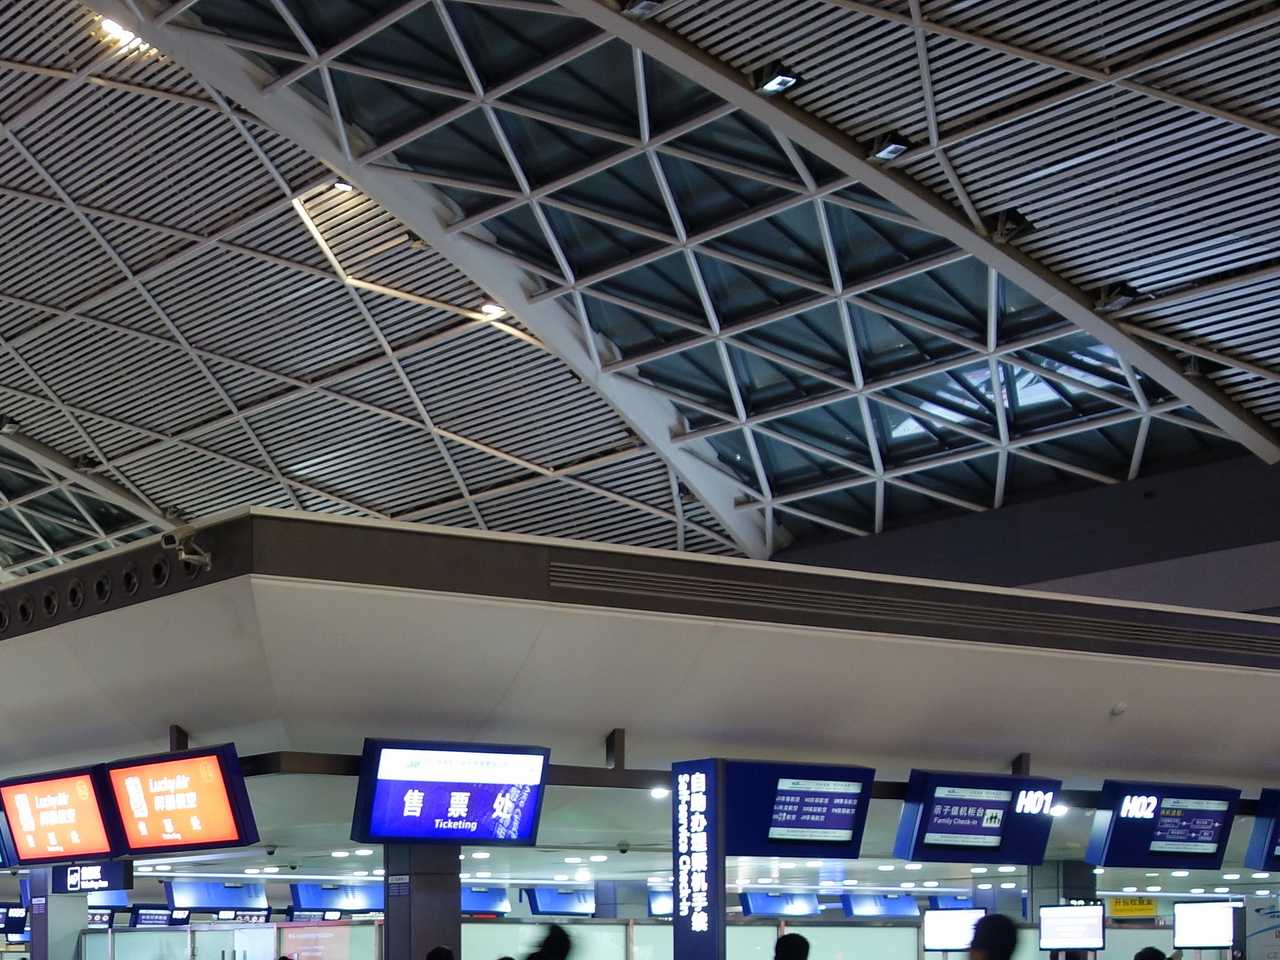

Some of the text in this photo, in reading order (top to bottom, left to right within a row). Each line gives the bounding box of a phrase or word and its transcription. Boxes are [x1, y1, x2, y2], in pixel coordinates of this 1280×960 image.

[1015, 790, 1054, 815] H01
[1120, 795, 1157, 819] H02
[434, 818, 478, 831] Ticketing
